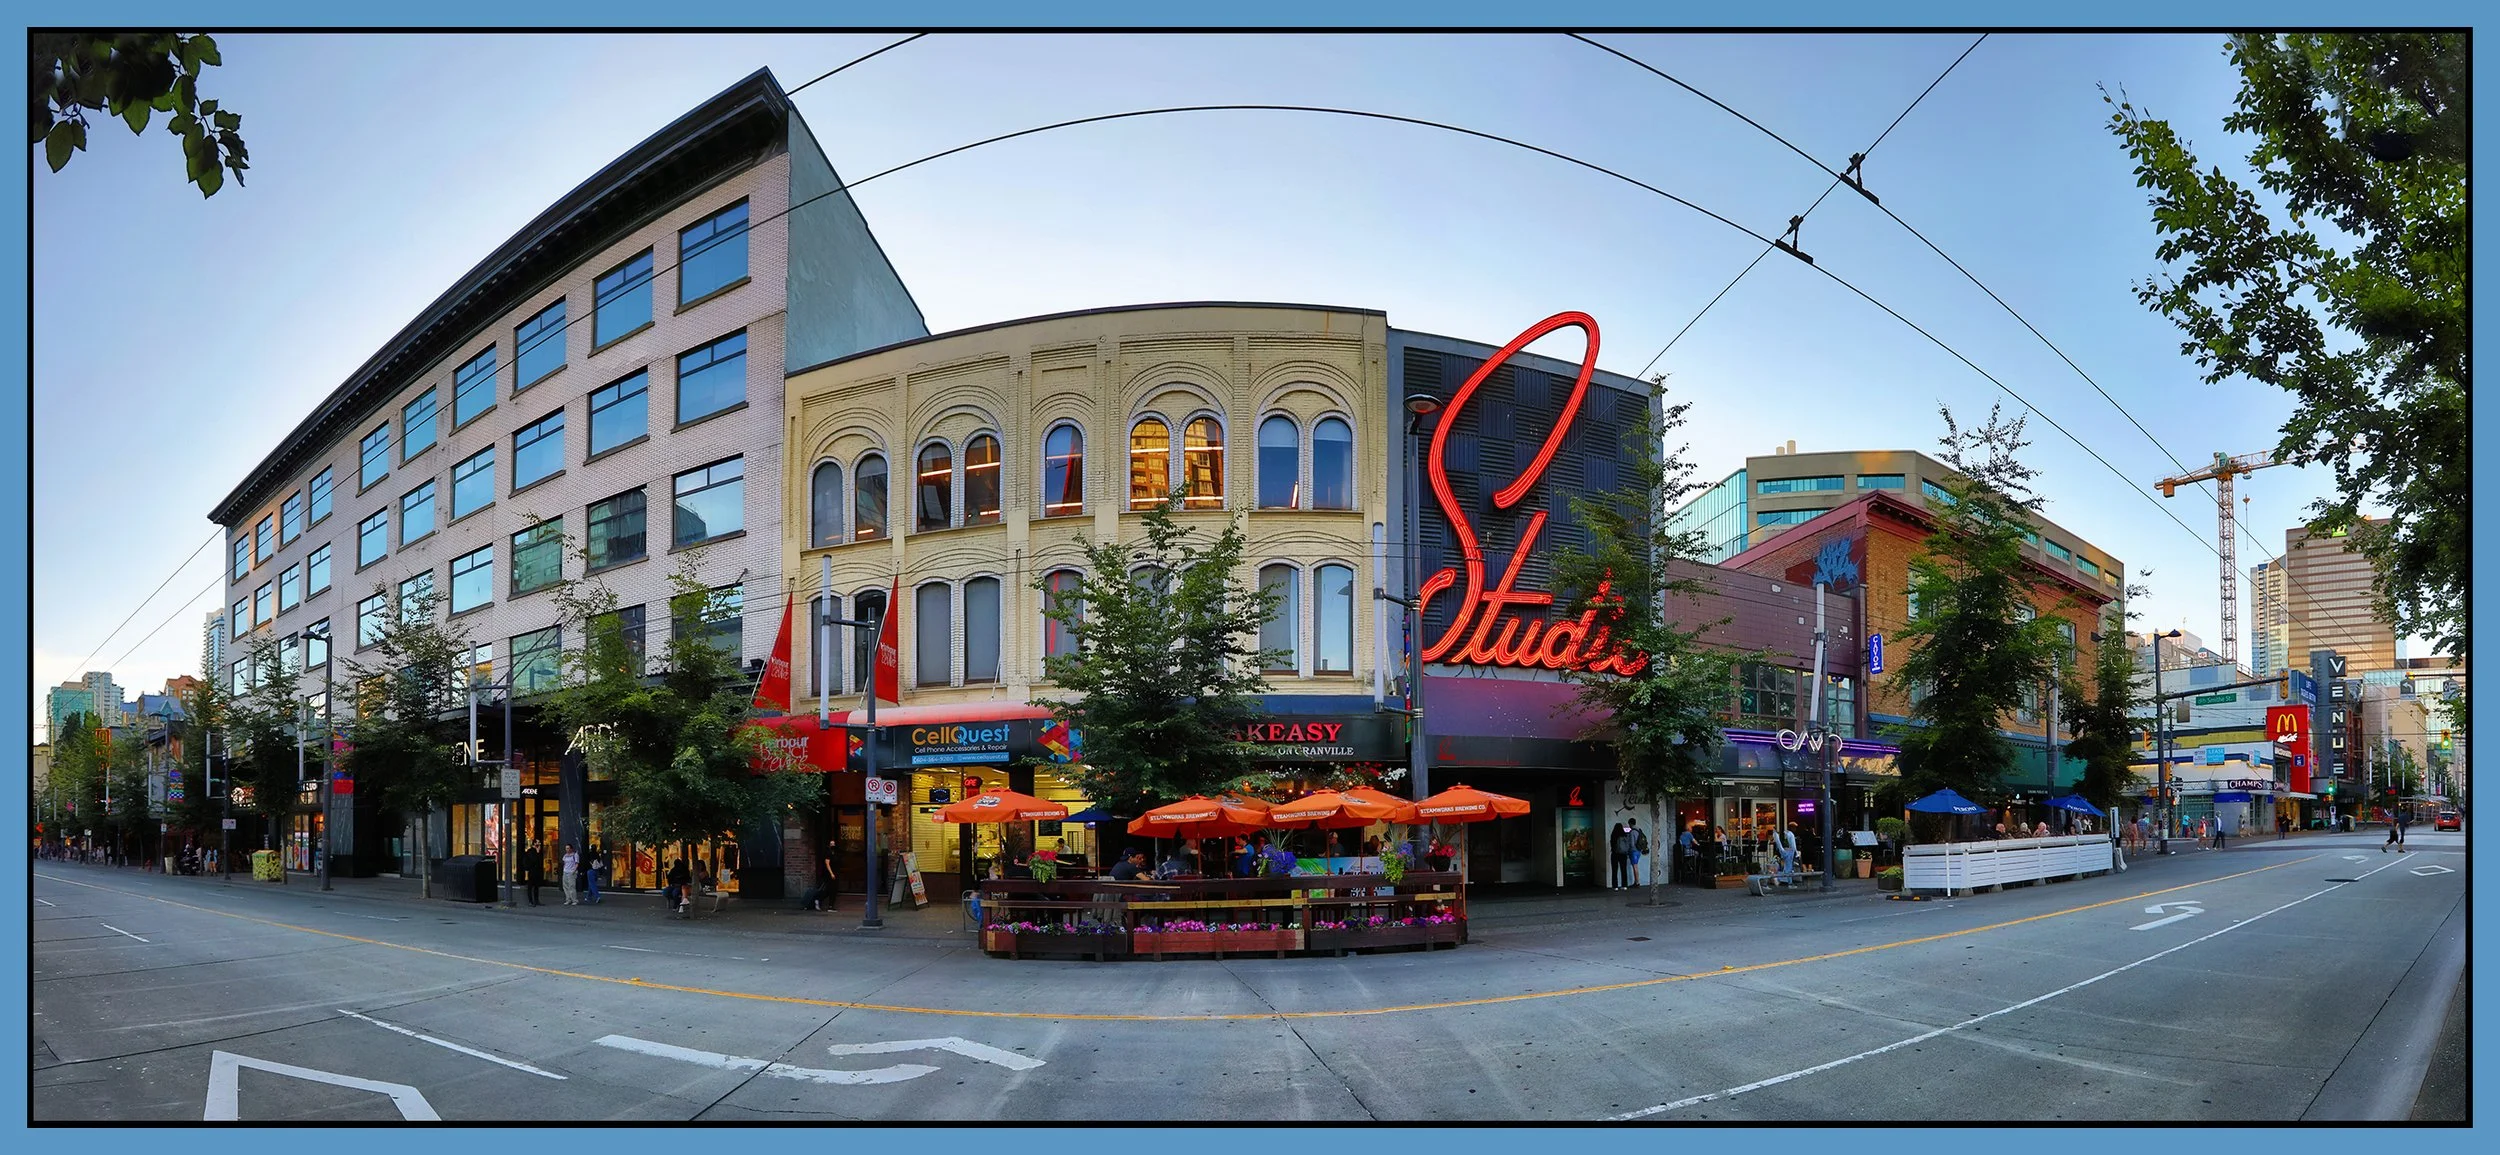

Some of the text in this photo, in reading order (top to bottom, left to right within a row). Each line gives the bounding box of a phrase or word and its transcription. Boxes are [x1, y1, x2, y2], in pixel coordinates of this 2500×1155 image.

[1420, 311, 1649, 678] Studio
[2329, 657, 2345, 775] VENUE
[911, 724, 1010, 746] CellQuest
[915, 746, 926, 754] Cell
[927, 745, 945, 753] Phone
[946, 744, 980, 752] Accessories
[988, 743, 1008, 751] Repair
[1273, 811, 1306, 820] STEAMWORKS
[1420, 806, 1454, 814] STEAMWORKS
[1149, 813, 1184, 821] STEAMWORKS
